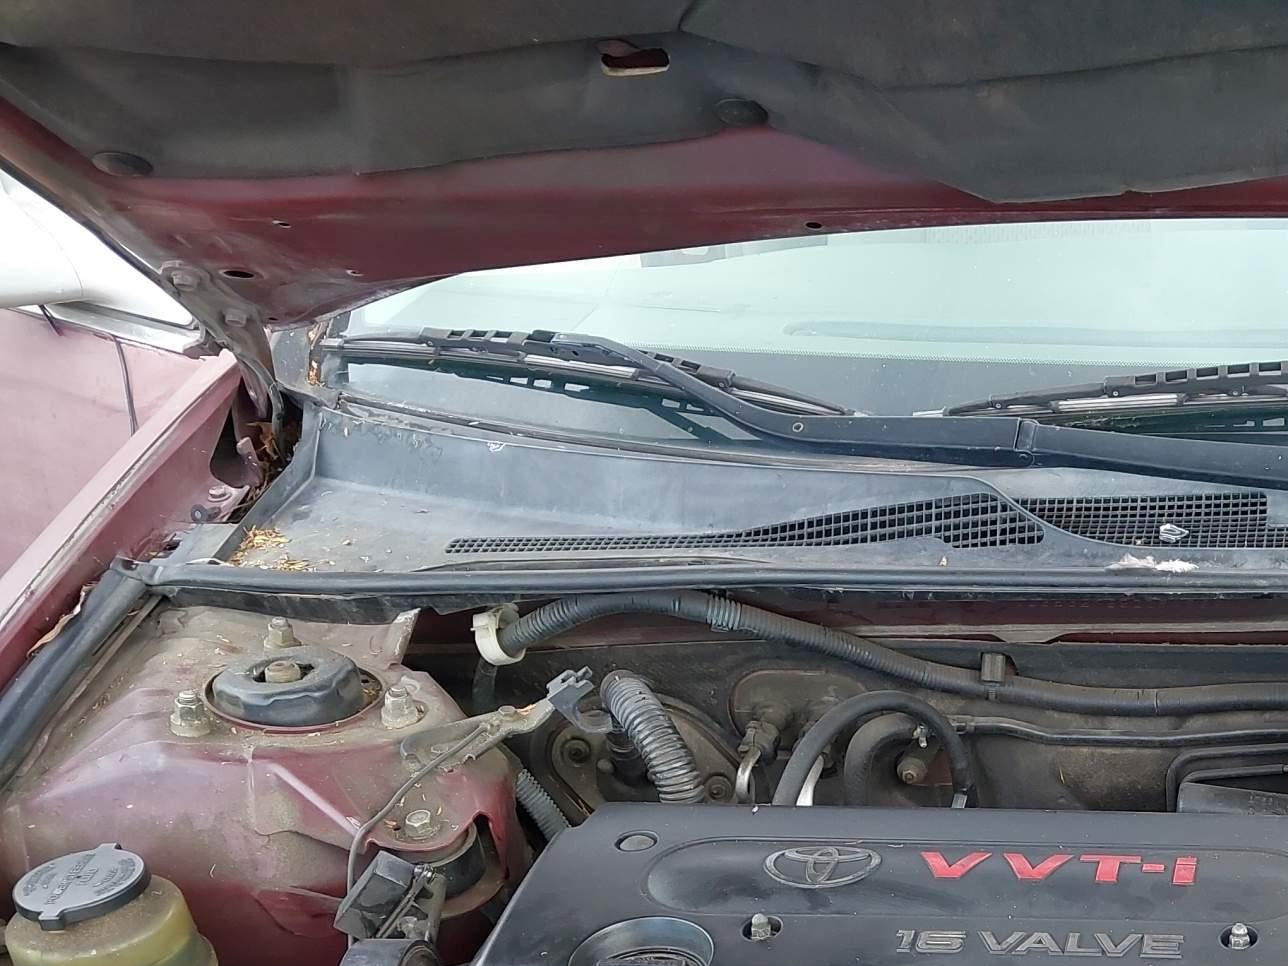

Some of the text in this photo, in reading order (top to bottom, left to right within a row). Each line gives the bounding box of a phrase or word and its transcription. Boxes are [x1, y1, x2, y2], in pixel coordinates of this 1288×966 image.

[920, 851, 1198, 886] VVT-i
[895, 929, 1185, 960] 16 VALVE
